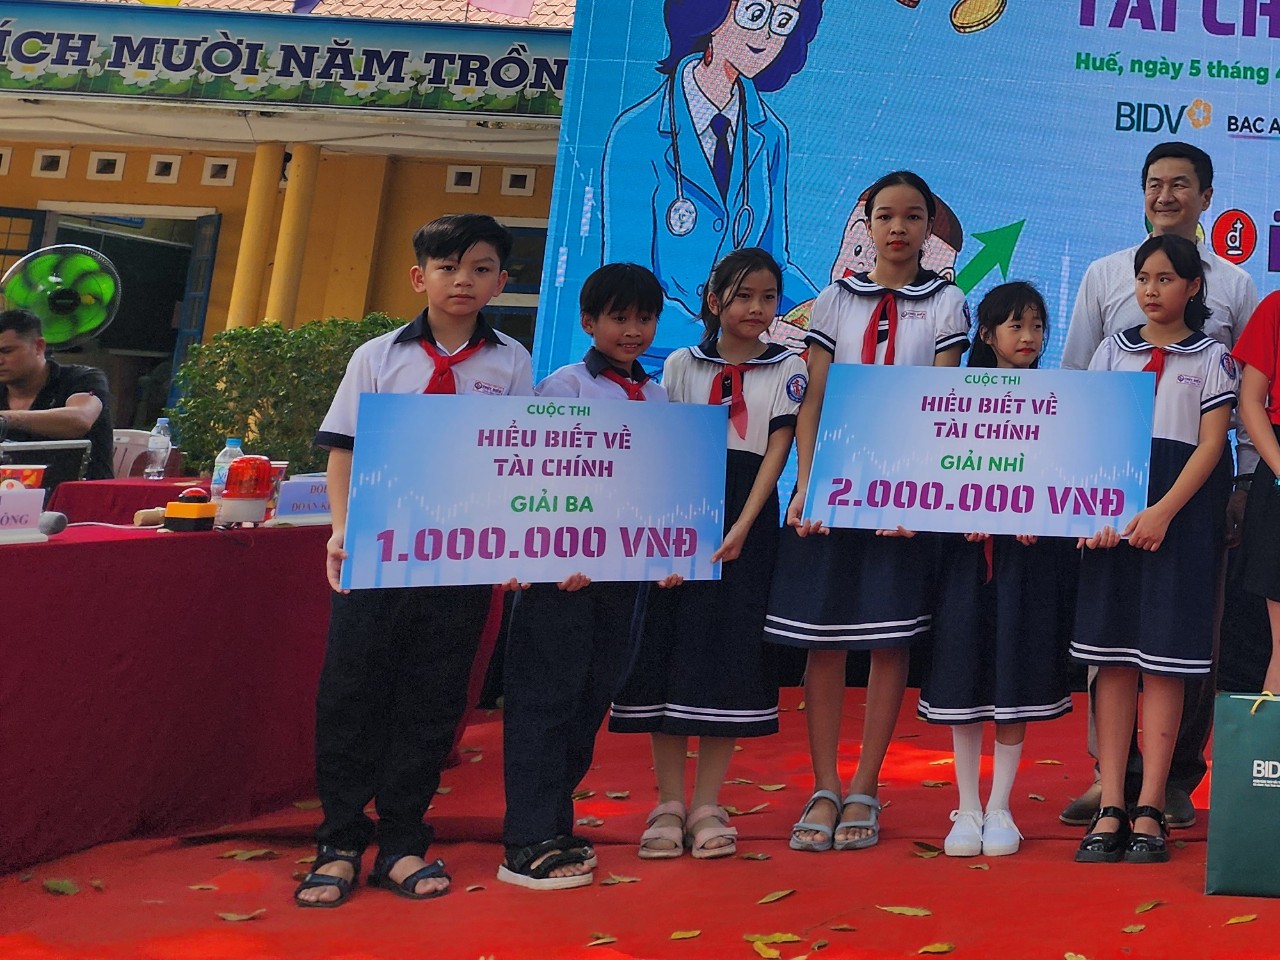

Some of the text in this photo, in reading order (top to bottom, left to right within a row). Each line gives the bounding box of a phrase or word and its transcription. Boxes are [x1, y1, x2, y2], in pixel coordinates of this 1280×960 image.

[107, 30, 264, 77] MƯỜI
[276, 38, 410, 84] NĂM
[1075, 51, 1123, 76] Huế,
[1129, 56, 1183, 80] ngày
[1188, 59, 1201, 77] 5
[1206, 60, 1269, 85] tháng
[1115, 101, 1188, 134] BIDV
[1227, 115, 1265, 134] BAC
[964, 372, 1021, 388] CUỘC THI
[526, 403, 591, 418] CUỘC THI
[921, 388, 1058, 416] HIỂU BIẾT VỀ
[477, 419, 632, 450] HIỂU BIẾT VỀ
[933, 418, 1040, 441] TÀI CHÍNH
[493, 453, 614, 478] TÀI CHÍNH
[940, 450, 1025, 474] GIẢI NHÌ
[510, 489, 594, 513] GIẢI BA
[827, 477, 1125, 518] 2.000.000 VNĐ
[376, 526, 699, 563] 1.000.000 VNĐ
